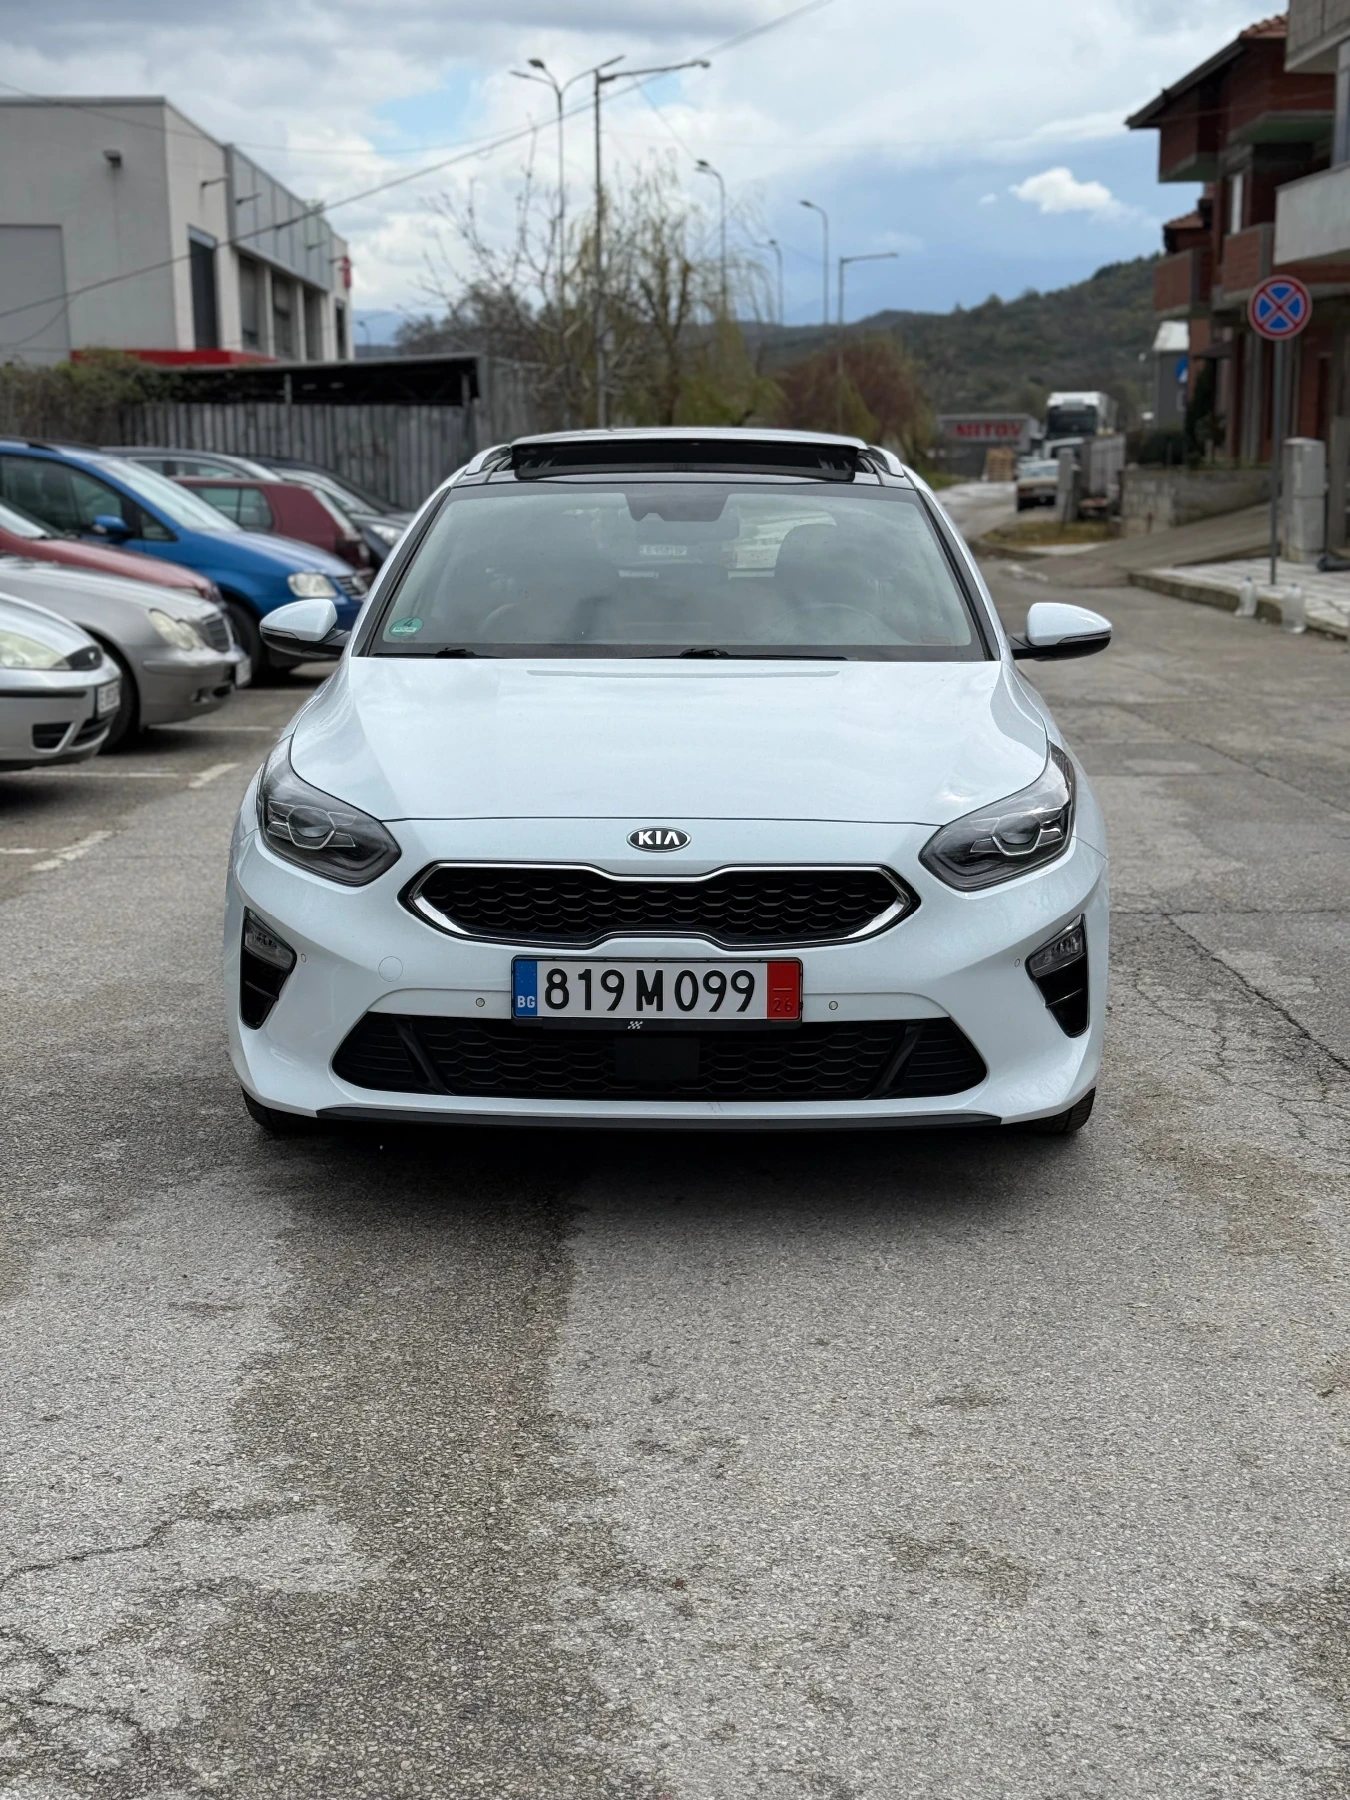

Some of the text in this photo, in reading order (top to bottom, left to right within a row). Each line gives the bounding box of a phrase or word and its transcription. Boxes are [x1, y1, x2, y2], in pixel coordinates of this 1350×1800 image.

[638, 830, 680, 846] KIA
[517, 995, 536, 1009] BG
[773, 997, 793, 1013] 26
